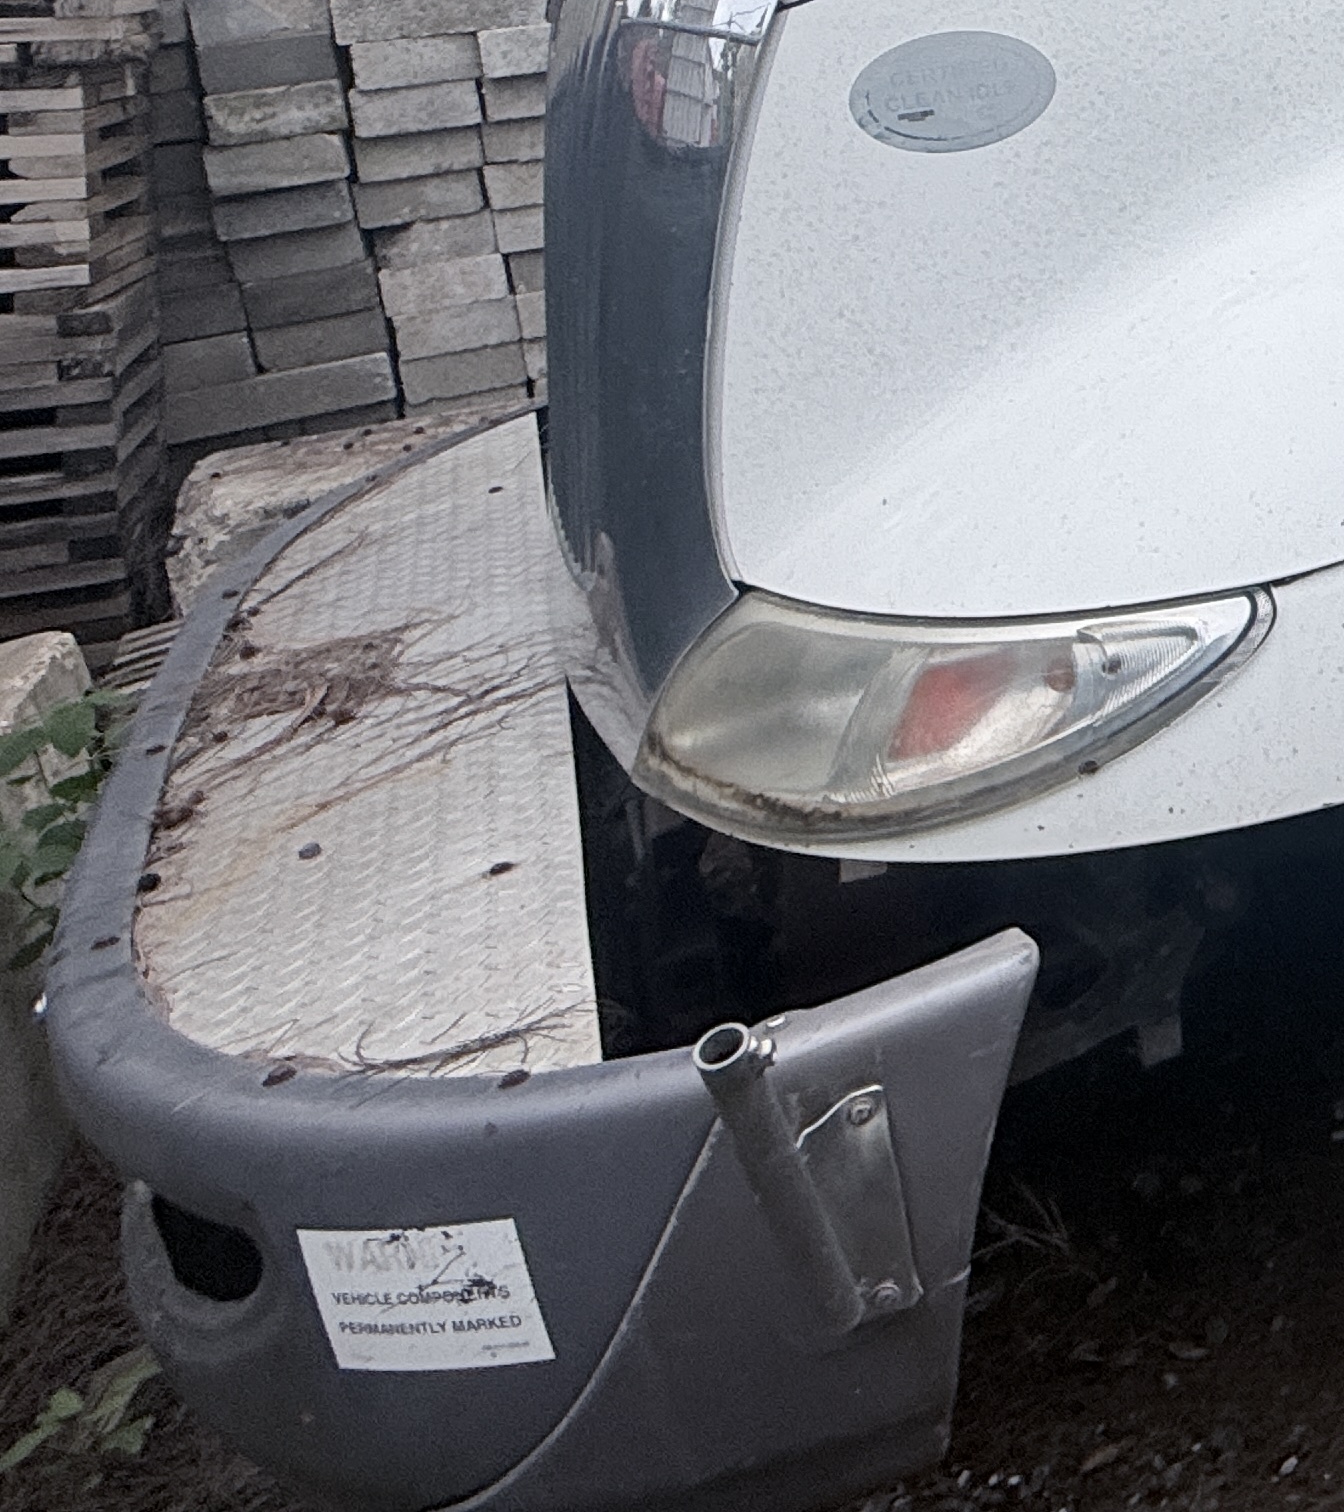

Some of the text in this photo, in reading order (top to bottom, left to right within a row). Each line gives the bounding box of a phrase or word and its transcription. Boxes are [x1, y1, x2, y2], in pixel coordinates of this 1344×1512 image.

[331, 1291, 394, 1306] VEHICLE
[339, 1315, 523, 1336] PERMANENTLY MARKED
